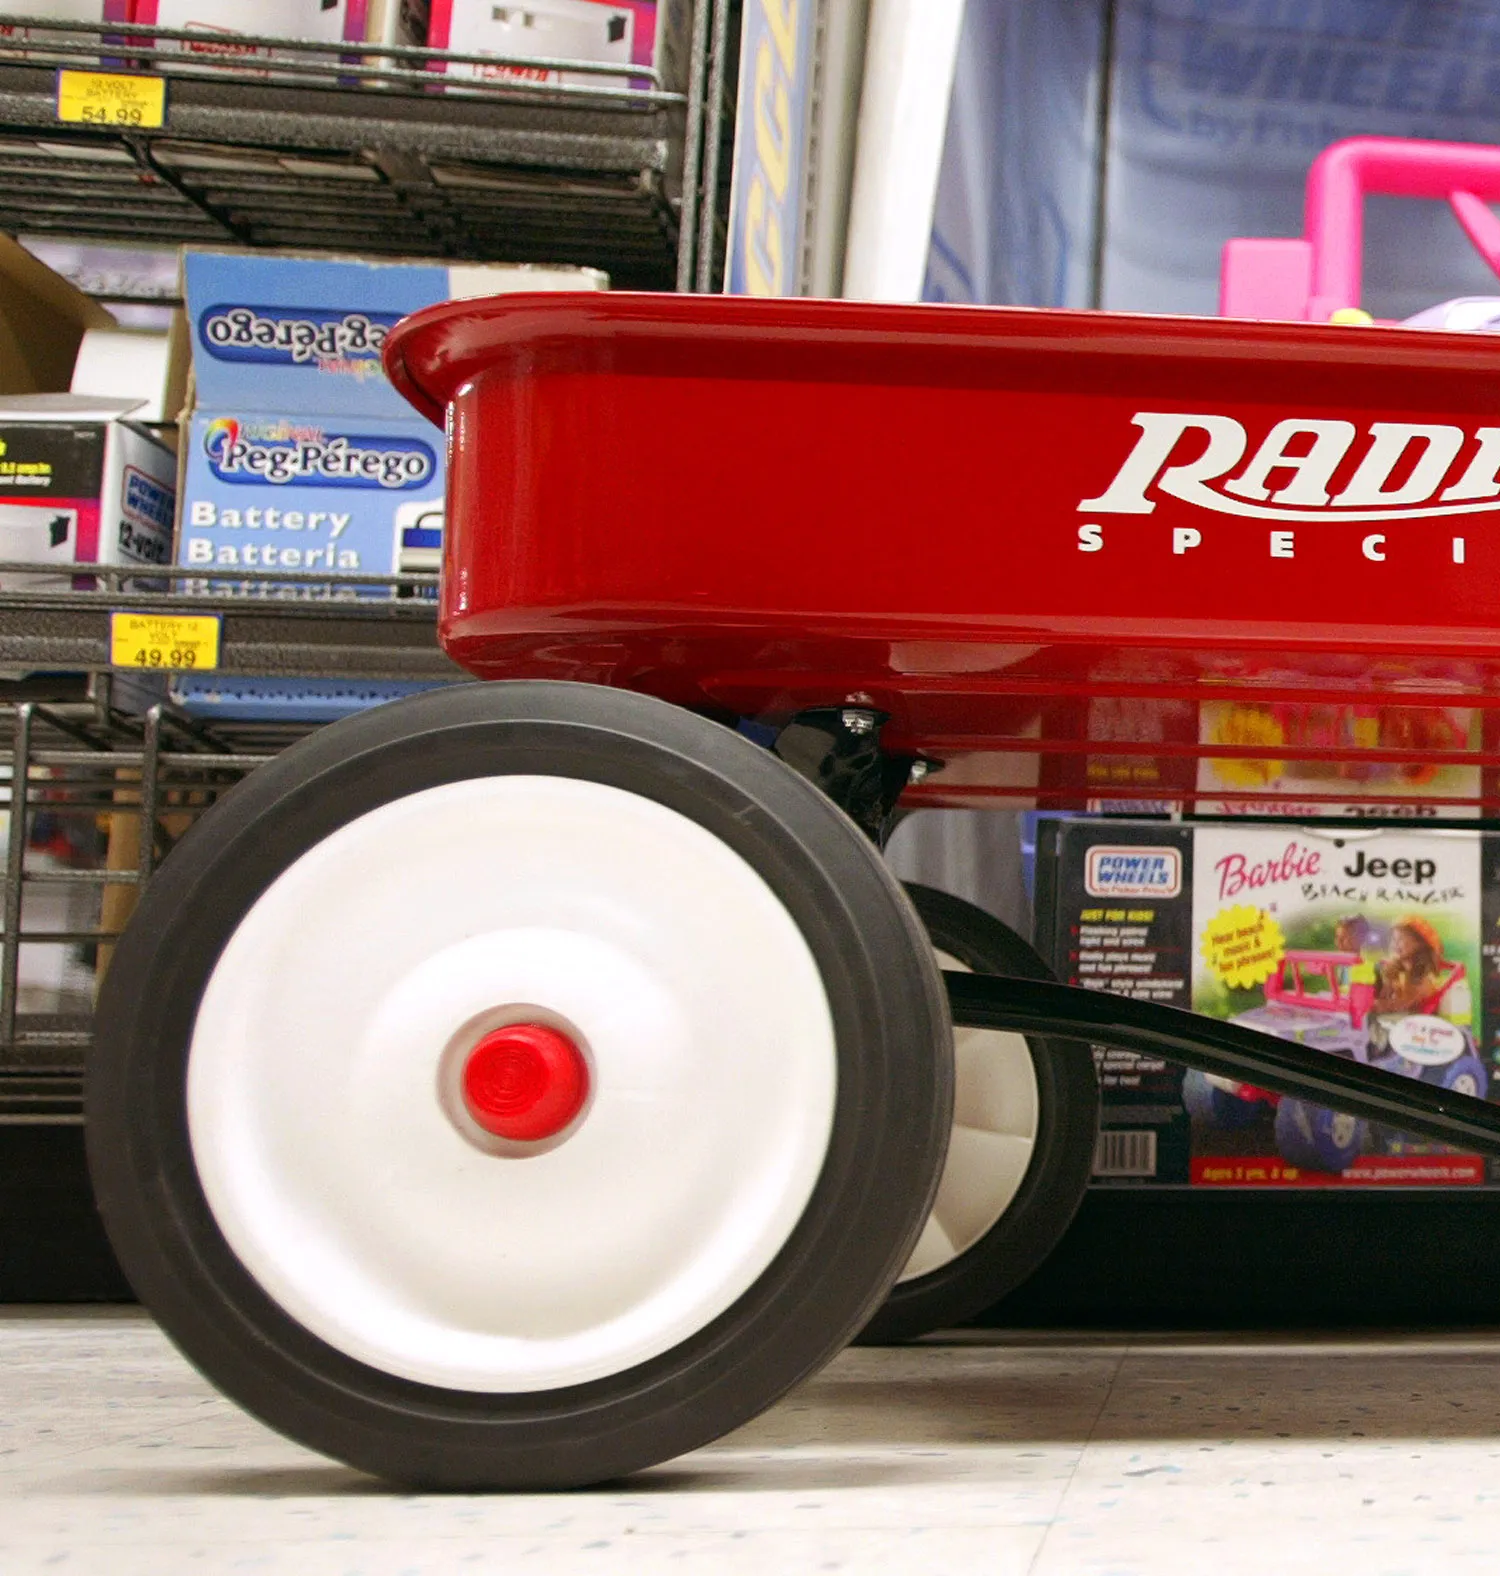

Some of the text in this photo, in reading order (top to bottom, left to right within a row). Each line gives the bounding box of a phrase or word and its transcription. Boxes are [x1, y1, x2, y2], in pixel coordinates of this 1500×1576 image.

[81, 105, 143, 126] 54.99
[190, 501, 352, 538] Battery
[187, 538, 360, 569] Batteria
[134, 648, 197, 669] 49.99
[1099, 856, 1166, 869] POWER
[1215, 842, 1322, 901] Barbie
[1343, 851, 1437, 885] Jeep
[1097, 871, 1170, 885] WHEELS
